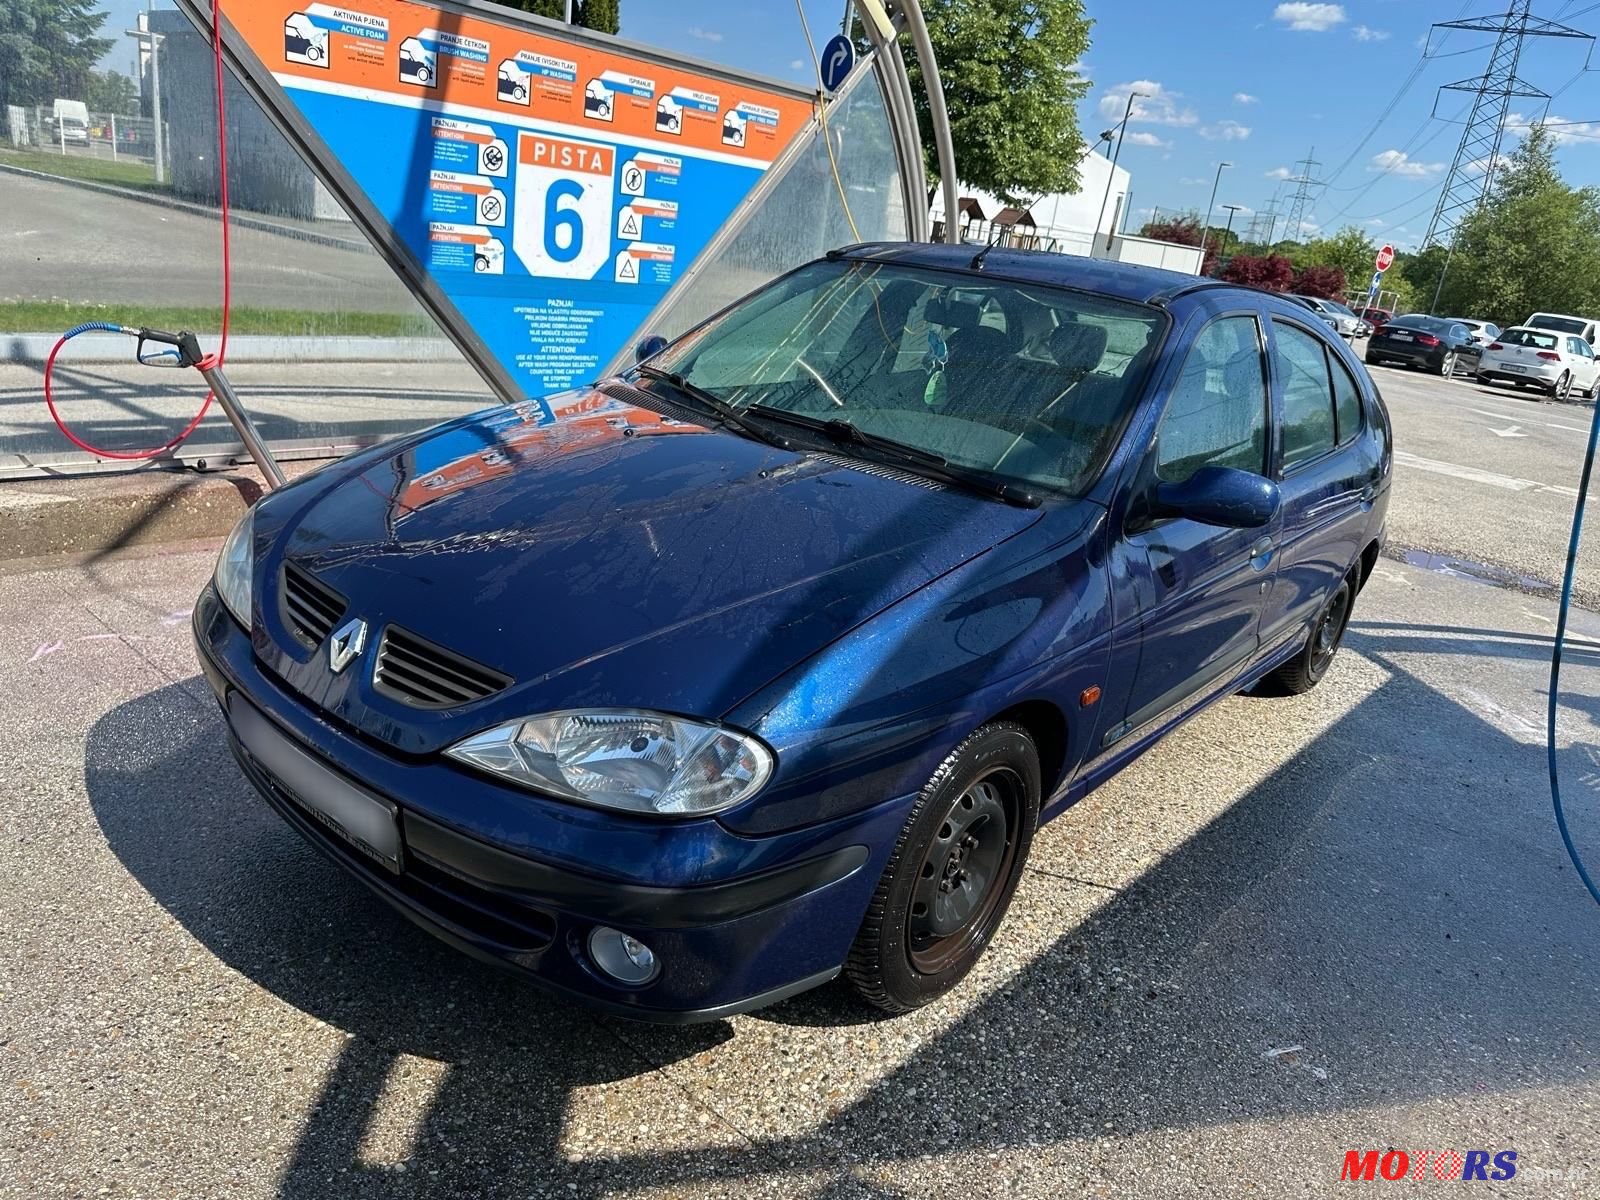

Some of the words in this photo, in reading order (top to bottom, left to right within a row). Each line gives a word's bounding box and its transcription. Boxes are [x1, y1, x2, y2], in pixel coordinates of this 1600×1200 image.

[333, 10, 362, 23] AKTIVNA
[363, 17, 385, 28] PJENA
[341, 24, 365, 36] ACTIVE
[365, 29, 385, 40] FOAM
[440, 34, 464, 45] PRANJE
[464, 39, 487, 50] ČETKOM
[440, 45, 459, 56] BRUSH
[460, 50, 487, 62] WASHING
[520, 52, 541, 63] PRANJE
[534, 142, 603, 171] PISTA
[544, 178, 585, 263] 6
[1377, 251, 1393, 265] STOP
[515, 353, 526, 361] USE
[533, 353, 546, 361] YOUR
[541, 345, 577, 354] ATTENTION!
[518, 361, 534, 369] AFTER
[534, 361, 549, 369] WASH
[549, 361, 571, 369] PROGRAM
